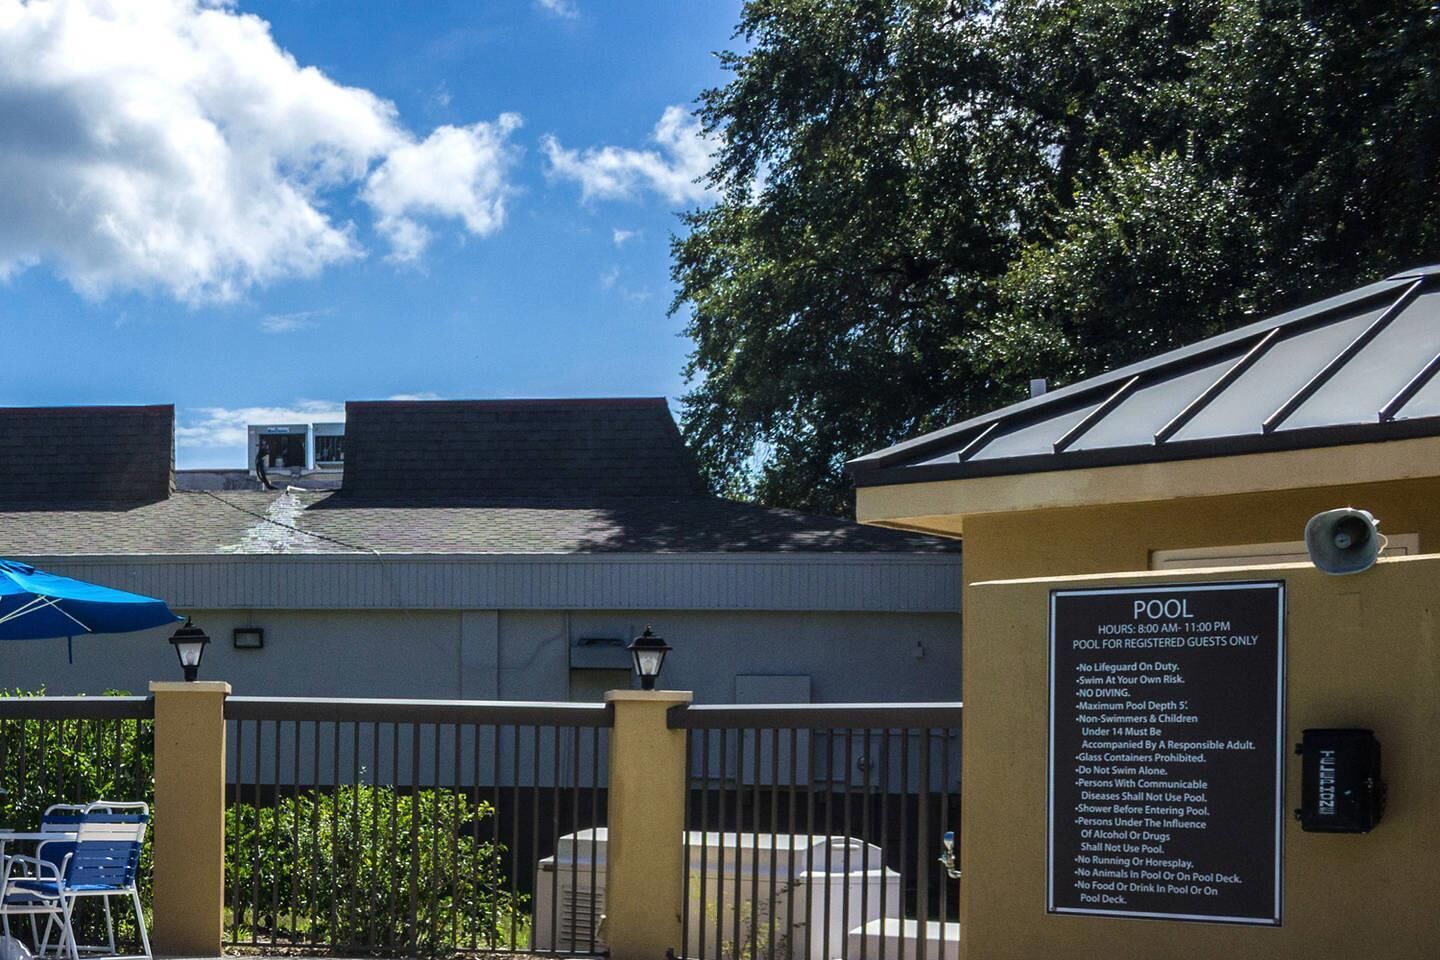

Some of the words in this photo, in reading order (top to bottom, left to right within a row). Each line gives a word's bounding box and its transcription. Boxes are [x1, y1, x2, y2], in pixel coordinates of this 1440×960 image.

[1134, 599, 1193, 619] POOL
[1098, 624, 1136, 634] HOURS:
[1138, 624, 1159, 634] 8:00
[1185, 622, 1212, 632] 11:00
[1214, 621, 1231, 631] PM
[1072, 640, 1100, 649] POOL
[1102, 639, 1122, 649] FOR
[1124, 637, 1185, 648] REGISTERED
[1186, 636, 1227, 647] GUESTS
[1229, 636, 1258, 646] ONLY
[1079, 664, 1092, 672] No
[1094, 662, 1137, 673] Lifeguard
[1138, 662, 1152, 671] On
[1154, 662, 1179, 672] Duty.
[1079, 676, 1103, 685] Swim
[1105, 676, 1115, 684] At
[1117, 676, 1138, 684] Your
[1139, 675, 1161, 684] Own
[1163, 674, 1184, 683] Risk.
[1079, 689, 1093, 697] NO
[1095, 688, 1130, 697] DIVING.
[1079, 702, 1124, 710] Maximum
[1125, 701, 1146, 710] Pool
[1147, 701, 1176, 712] Depth
[1079, 714, 1147, 723] Non-Swimmers
[1149, 714, 1156, 723] &
[1158, 714, 1198, 723] Children
[1082, 727, 1110, 736] Under
[1112, 727, 1123, 736] 14
[1124, 728, 1147, 736] Must
[1149, 727, 1161, 736] Be
[1081, 740, 1143, 749] Accompanied
[1145, 740, 1157, 751] By
[1158, 740, 1165, 749] A
[1167, 740, 1224, 752] Responsible
[1226, 741, 1255, 749] Adult.
[1078, 753, 1102, 761] Glass
[1103, 753, 1152, 762] Containers
[1154, 753, 1206, 762] Prohibited.
[1078, 765, 1091, 774] Do
[1093, 766, 1110, 774] Not
[1111, 766, 1136, 774] Swim
[1138, 766, 1167, 775] Alone.
[1078, 778, 1113, 787] Persons
[1114, 779, 1135, 788] With
[1137, 779, 1207, 789] Communicable
[1319, 750, 1335, 815] TELEPHONE
[1081, 791, 1120, 800] Diseases
[1121, 792, 1143, 801] Shall
[1145, 793, 1162, 801] Not
[1164, 793, 1181, 802] Use
[1183, 793, 1207, 802] Pool.
[1078, 804, 1112, 813] Shower
[1113, 805, 1143, 814] Before
[1144, 805, 1184, 817] Entering
[1186, 806, 1209, 815] Pool.
[1078, 817, 1112, 826] Persons
[1114, 818, 1143, 827] Under
[1143, 818, 1161, 828] The
[1163, 819, 1206, 829] Influence
[1080, 829, 1092, 838] Of
[1093, 830, 1127, 839] Alcohol
[1129, 831, 1141, 840] Or
[1142, 831, 1170, 843] Drugs
[1080, 842, 1102, 851] Shall
[1104, 843, 1121, 852] Not
[1122, 844, 1140, 853] Use
[1141, 844, 1164, 854] Pool.
[1078, 855, 1090, 864] No
[1092, 856, 1130, 867] Running
[1131, 857, 1143, 866] Or
[1077, 868, 1090, 877] No
[1091, 869, 1128, 878] Animals
[1129, 870, 1139, 879] In
[1140, 870, 1161, 880] Pool
[1162, 871, 1175, 880] Or
[1176, 872, 1190, 881] On
[1192, 873, 1213, 882] Pool
[1215, 873, 1242, 883] Deck.
[1077, 880, 1090, 889] No
[1092, 881, 1114, 890] Food
[1116, 882, 1128, 891] Or
[1129, 883, 1154, 892] Drink
[1156, 884, 1165, 893] In
[1167, 884, 1188, 894] Pool
[1190, 886, 1202, 895] Or
[1203, 886, 1217, 895] On
[1080, 893, 1100, 902] Pool
[1101, 894, 1127, 904] Deck.
